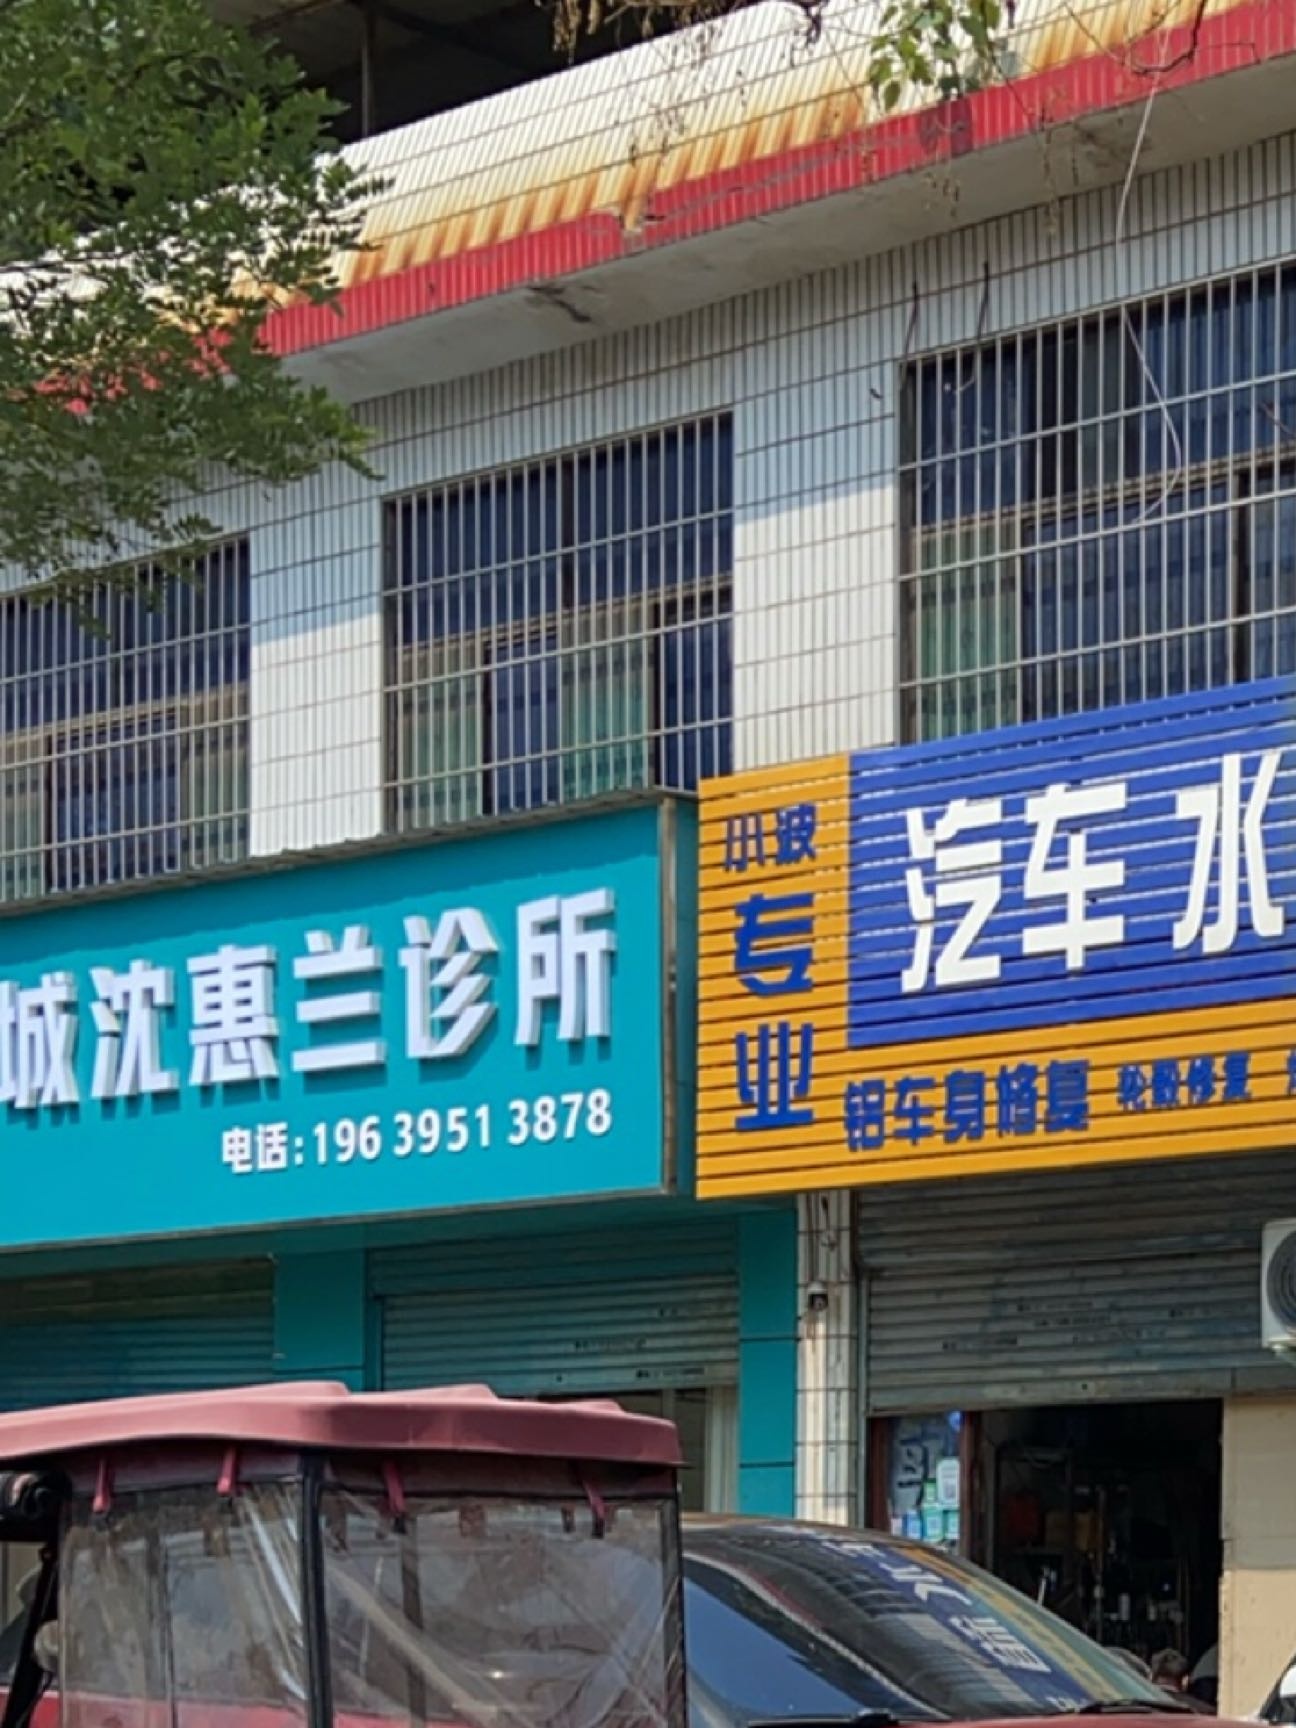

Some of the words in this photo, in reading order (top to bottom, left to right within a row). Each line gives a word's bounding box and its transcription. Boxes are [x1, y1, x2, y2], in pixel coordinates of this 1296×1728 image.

[734, 893, 815, 1132] 专业
[393, 1104, 491, 1158] 3951
[507, 1088, 613, 1146] 3878
